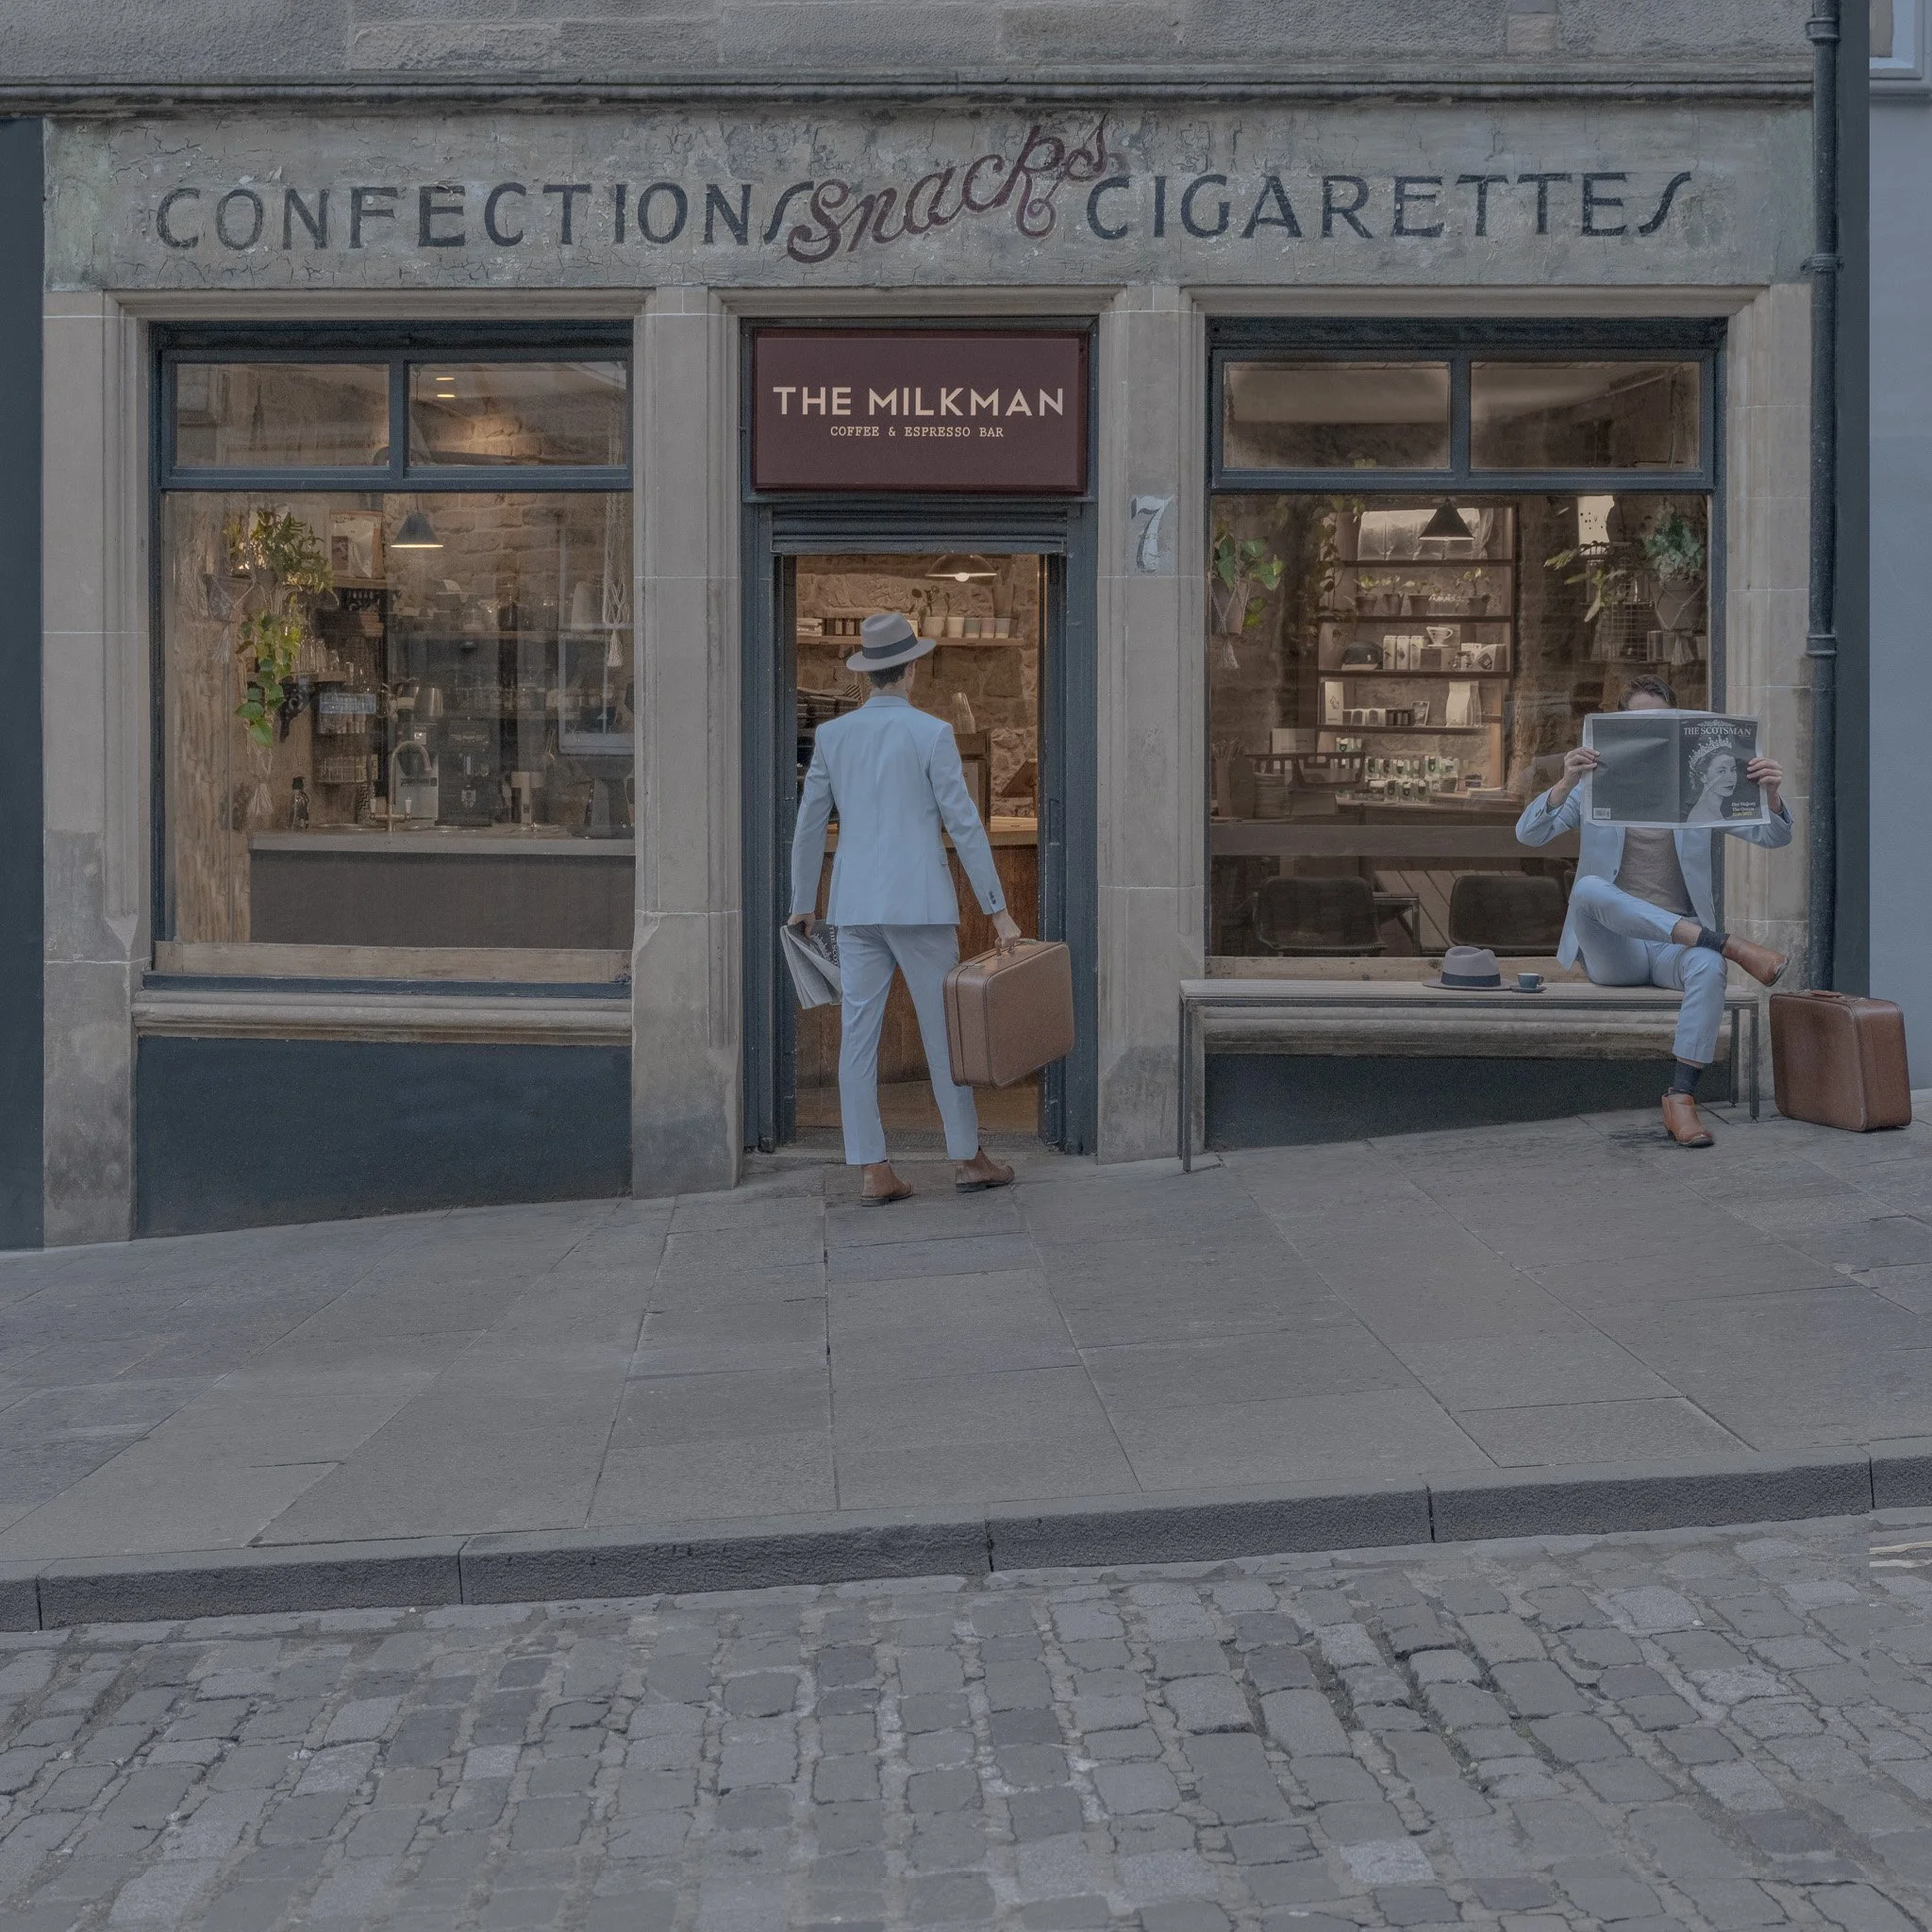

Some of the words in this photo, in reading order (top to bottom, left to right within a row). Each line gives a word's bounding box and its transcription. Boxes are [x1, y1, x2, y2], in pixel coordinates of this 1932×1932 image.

[1085, 171, 1692, 242] CIGARETTES
[772, 386, 852, 416] THE
[868, 386, 1064, 417] MILKMAN
[829, 425, 880, 438] COFFEE
[888, 425, 897, 438] &
[904, 425, 972, 439] ESPRESSO
[978, 425, 1005, 439] BAR
[1131, 493, 1175, 574] 7
[1683, 726, 1700, 736] THE
[1700, 726, 1752, 737] SCOTSMAN
